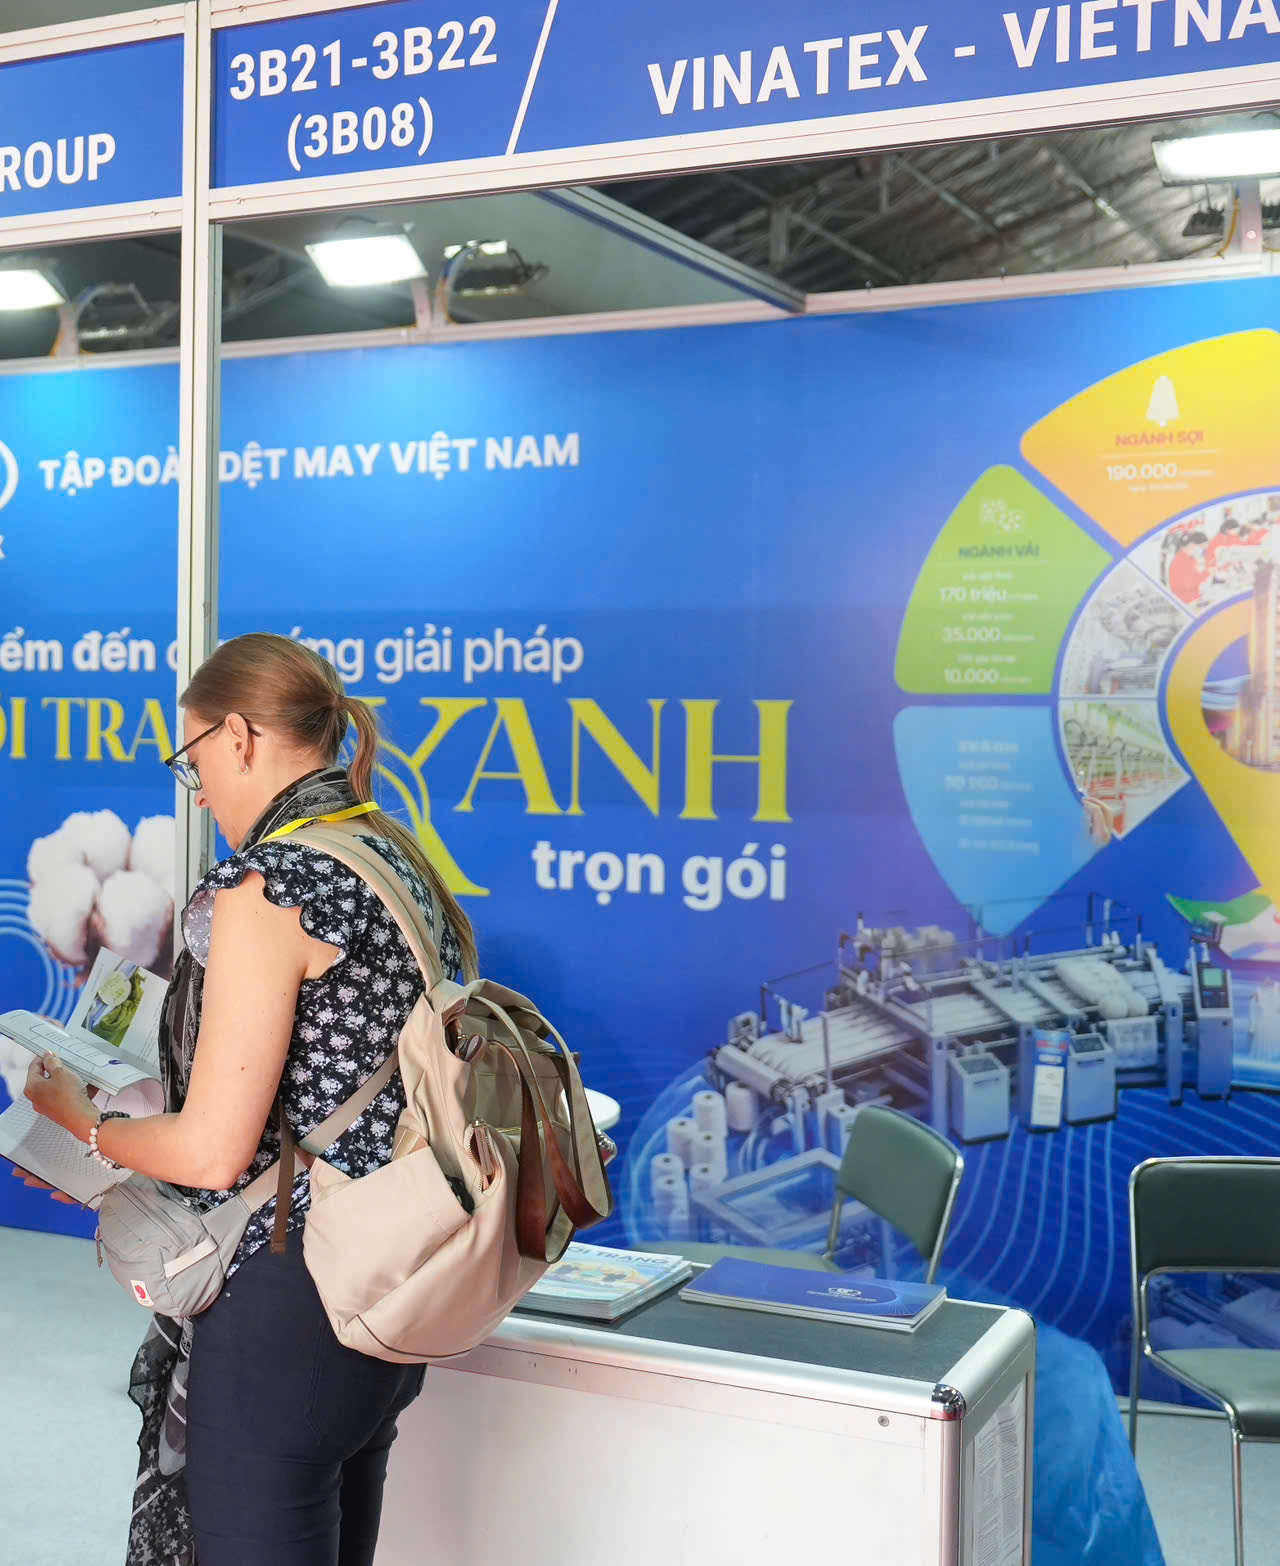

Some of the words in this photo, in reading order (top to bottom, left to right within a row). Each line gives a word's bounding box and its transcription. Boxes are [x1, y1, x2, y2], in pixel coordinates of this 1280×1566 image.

[228, 15, 499, 99] 3B21-3B22
[646, 25, 929, 115] VINATEX
[954, 45, 976, 57] -
[1002, 0, 1280, 68] VIETNA
[286, 96, 434, 169] (3B08)
[39, 450, 106, 496] TẬP
[110, 446, 179, 487] ĐOÀ
[218, 440, 287, 489] DỆT
[293, 442, 382, 479] MAY
[389, 431, 477, 481] VIỆT
[484, 432, 581, 470] NAM
[71, 625, 157, 672] đến
[374, 622, 454, 684] giải
[463, 622, 585, 685] pháp
[40, 696, 176, 763] TRA
[530, 839, 666, 906] trọn
[681, 841, 787, 912] gói
